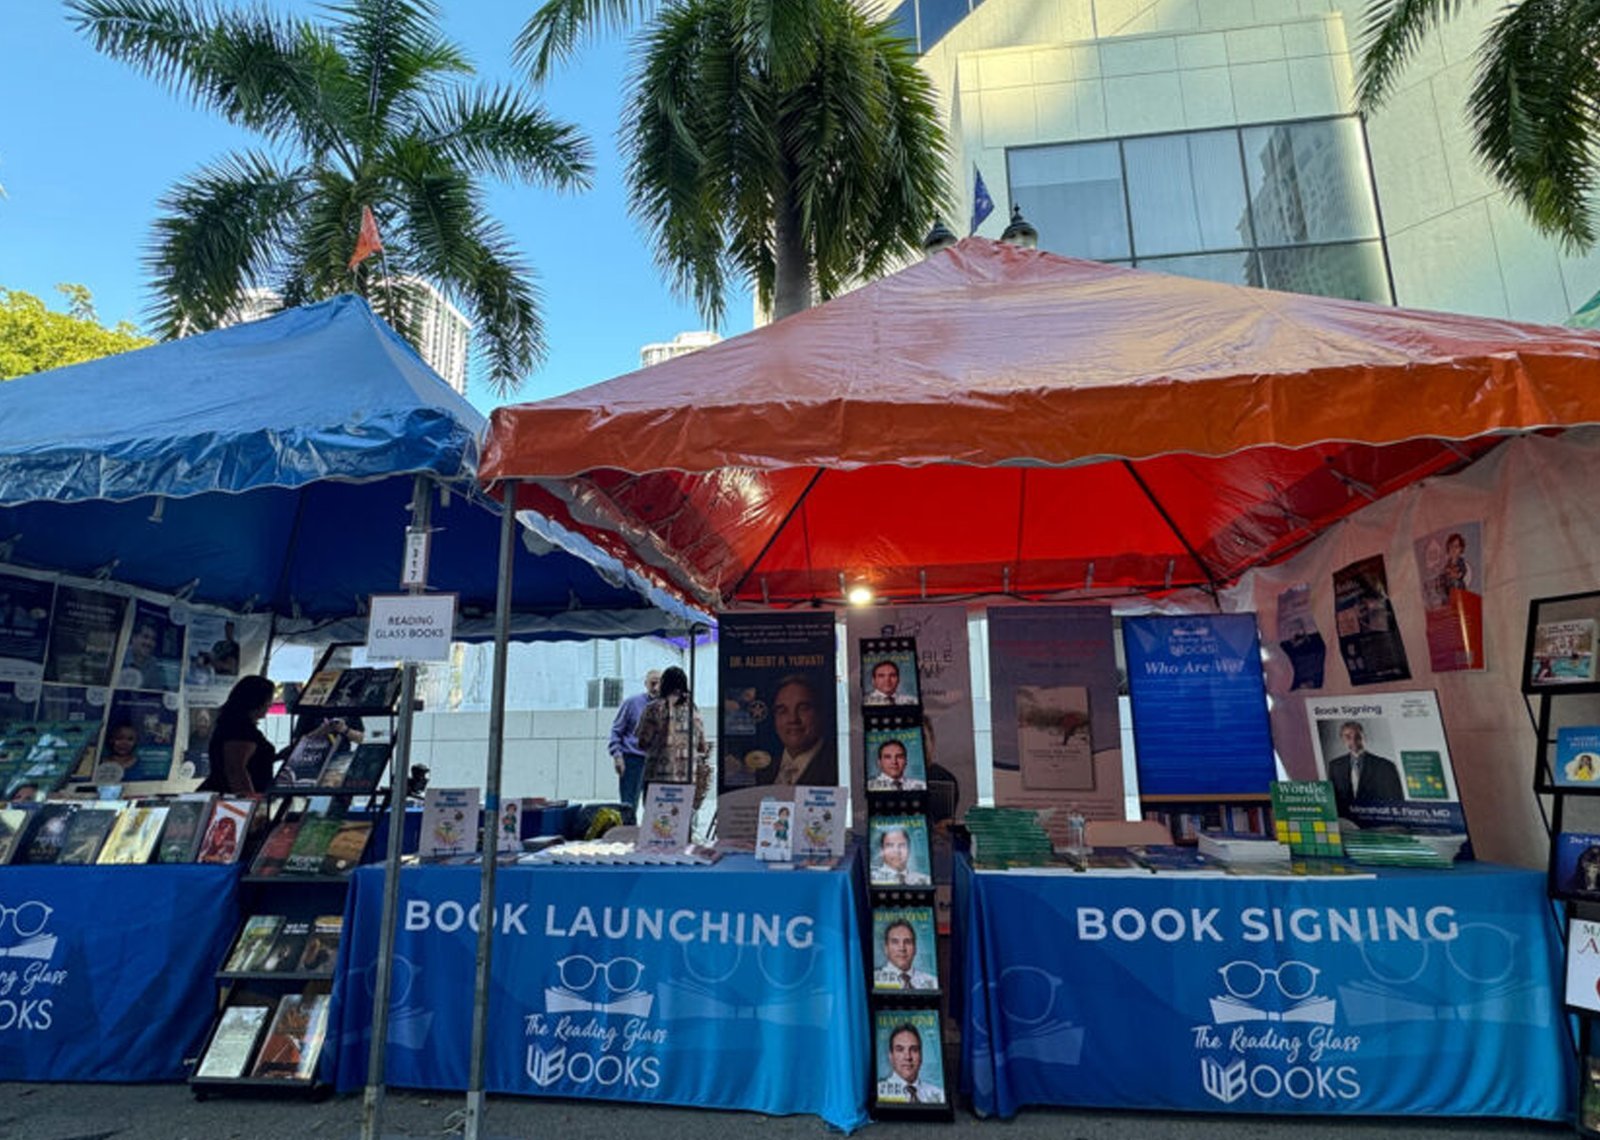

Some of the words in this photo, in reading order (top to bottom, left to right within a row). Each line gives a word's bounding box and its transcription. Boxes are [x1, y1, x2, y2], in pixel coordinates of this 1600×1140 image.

[375, 629, 406, 639] GLASS
[409, 628, 445, 638] BOOKS
[388, 615, 433, 626] READING
[1145, 661, 1179, 675] Who
[1184, 660, 1210, 673] Are
[1314, 706, 1338, 716] Book
[1341, 705, 1382, 715] Signing
[544, 904, 815, 949] LAUNCHING
[1077, 907, 1223, 942] BOOK
[1240, 905, 1459, 942] SIGNING
[20, 961, 68, 996] Glass
[524, 1013, 548, 1036] The
[554, 1015, 618, 1052] Reading
[622, 1018, 668, 1052] Glass
[1190, 1025, 1222, 1049] The
[1229, 1026, 1302, 1064] Reading
[1307, 1026, 1361, 1063] Glass
